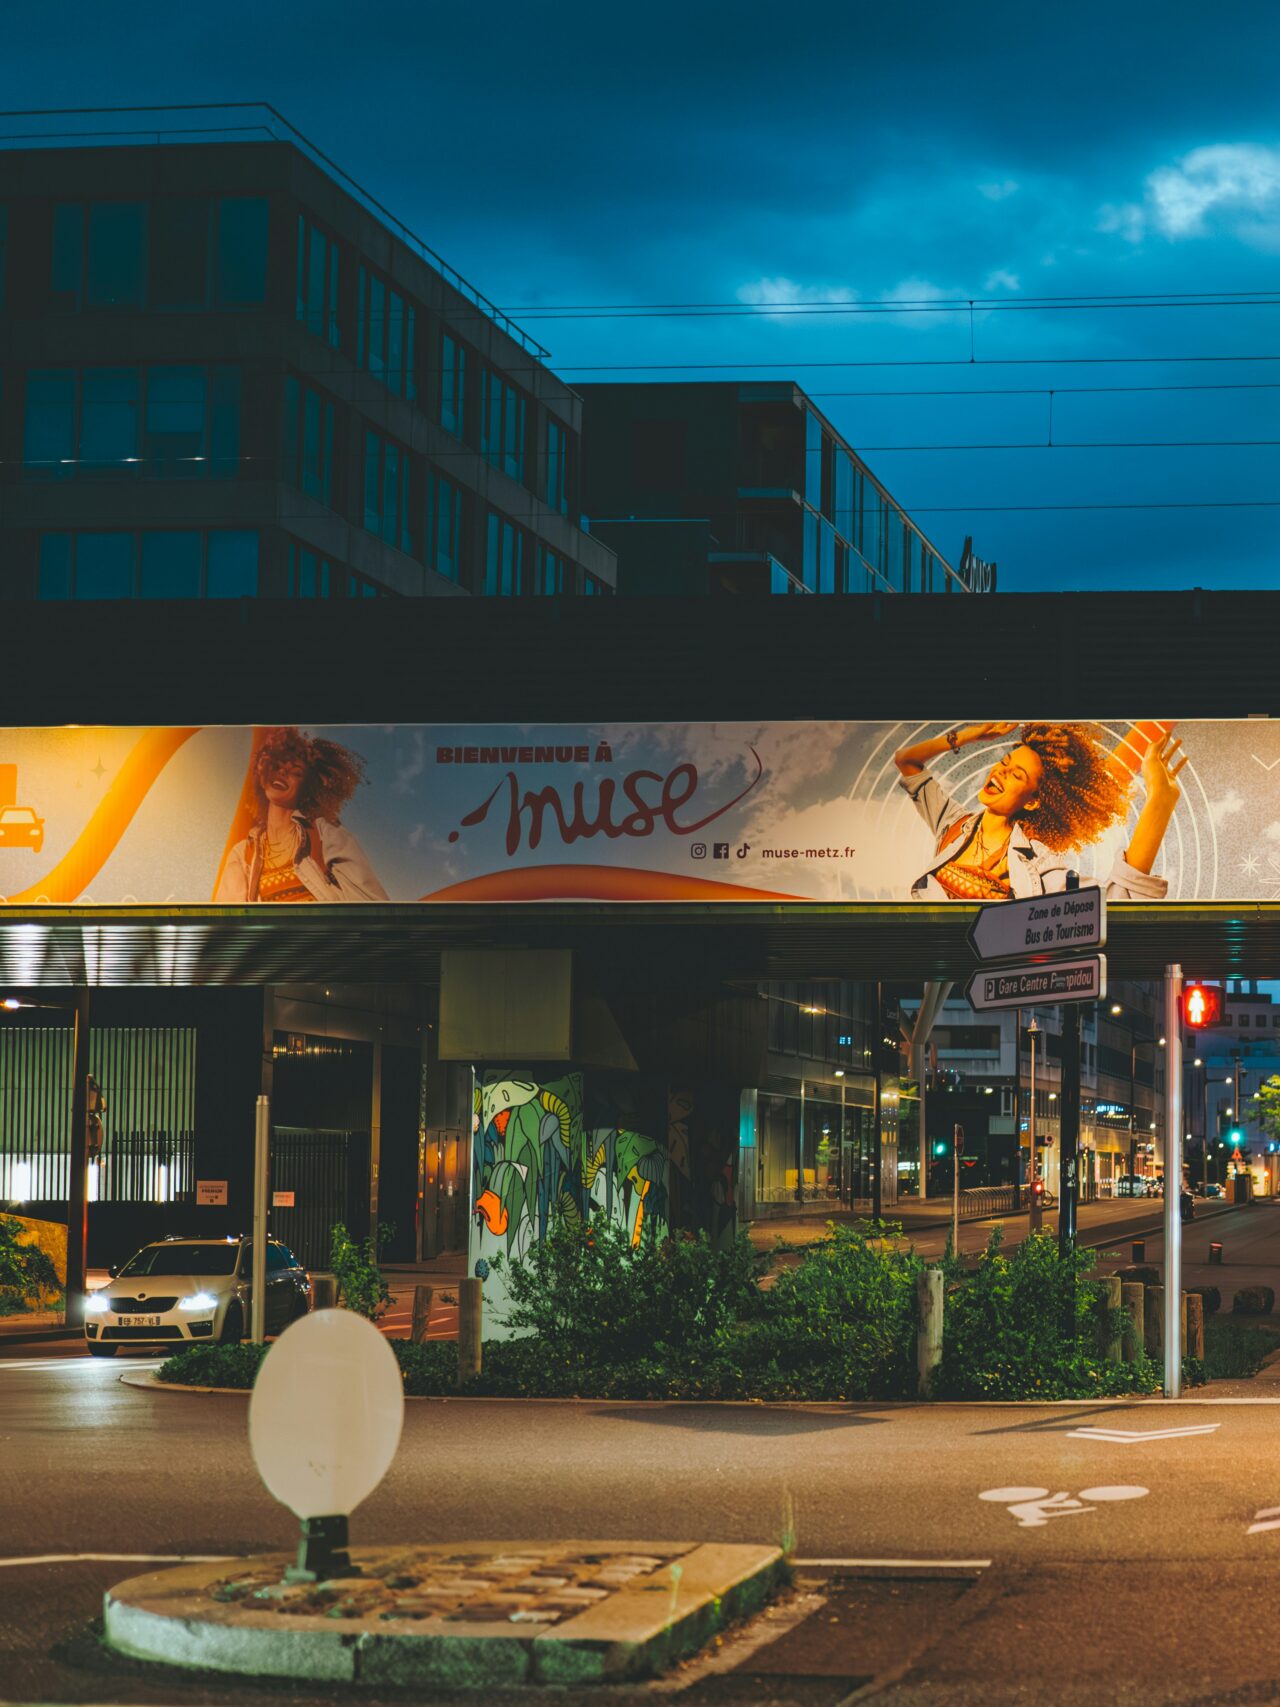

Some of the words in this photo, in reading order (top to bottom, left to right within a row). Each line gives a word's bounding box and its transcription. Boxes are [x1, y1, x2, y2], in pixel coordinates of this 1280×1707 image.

[436, 746, 589, 763] BIENVENUE
[458, 747, 763, 857] muse
[762, 846, 856, 859] muse-metz.fr
[1028, 907, 1049, 921] Zone
[1051, 904, 1062, 917] de
[1063, 900, 1094, 917] Dépose
[1025, 928, 1040, 945] Bus
[1043, 926, 1053, 943] de
[1055, 922, 1094, 940] Tourisme
[998, 978, 1018, 994] Gare
[1020, 976, 1048, 992] Centre
[1050, 970, 1092, 990] Ppidou
